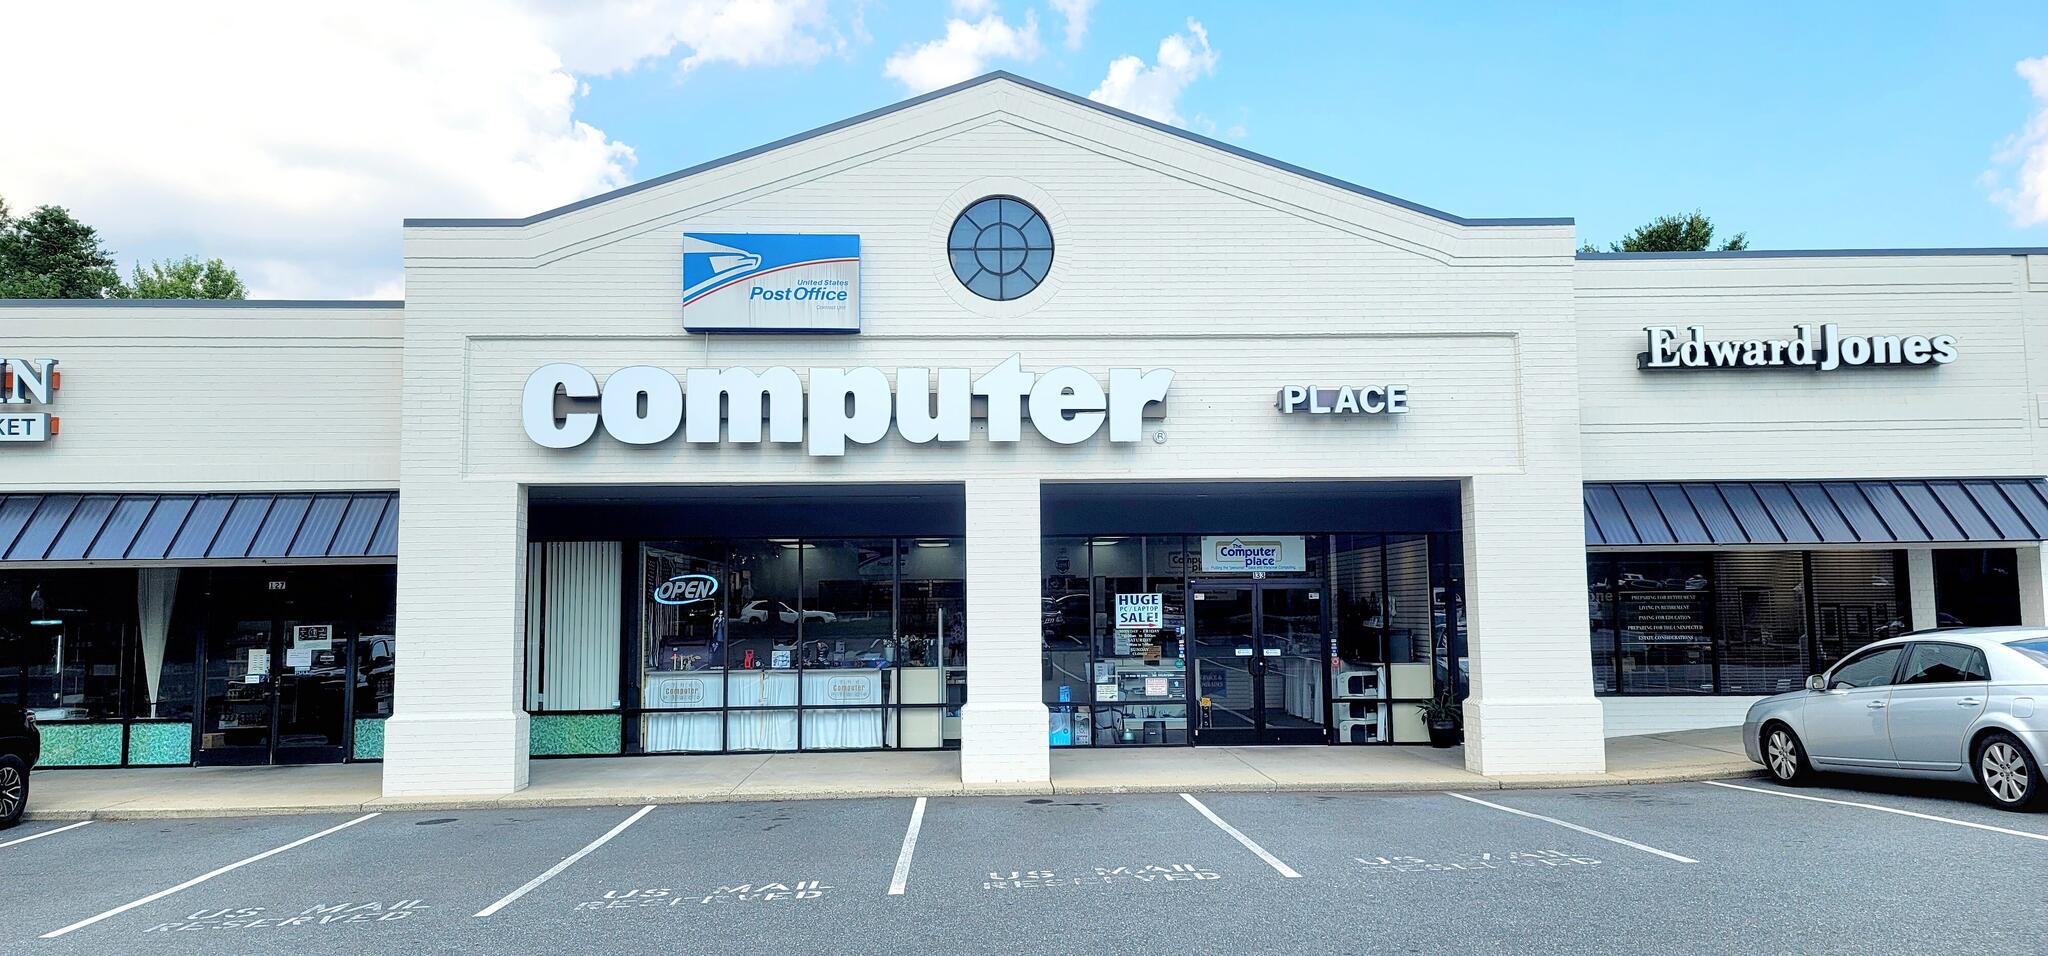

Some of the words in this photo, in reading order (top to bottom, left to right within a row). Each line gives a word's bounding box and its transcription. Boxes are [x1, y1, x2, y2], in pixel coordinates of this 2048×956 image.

[824, 279, 849, 287] States
[750, 286, 792, 300] Post
[794, 286, 848, 301] Office
[1643, 323, 1817, 368] Edward
[1820, 322, 1959, 371] Jones
[0, 358, 58, 404] N
[1282, 384, 1410, 414] PLACE
[1220, 547, 1276, 558] Computer
[1245, 557, 1275, 567] place
[659, 581, 711, 598] OPEN
[1119, 595, 1159, 605] HUGE
[1120, 613, 1159, 622] SALE!
[989, 870, 1056, 880] US
[603, 888, 672, 899] US
[186, 907, 266, 920] US
[300, 899, 432, 914] MAIL
[142, 911, 413, 933] RESERVED
